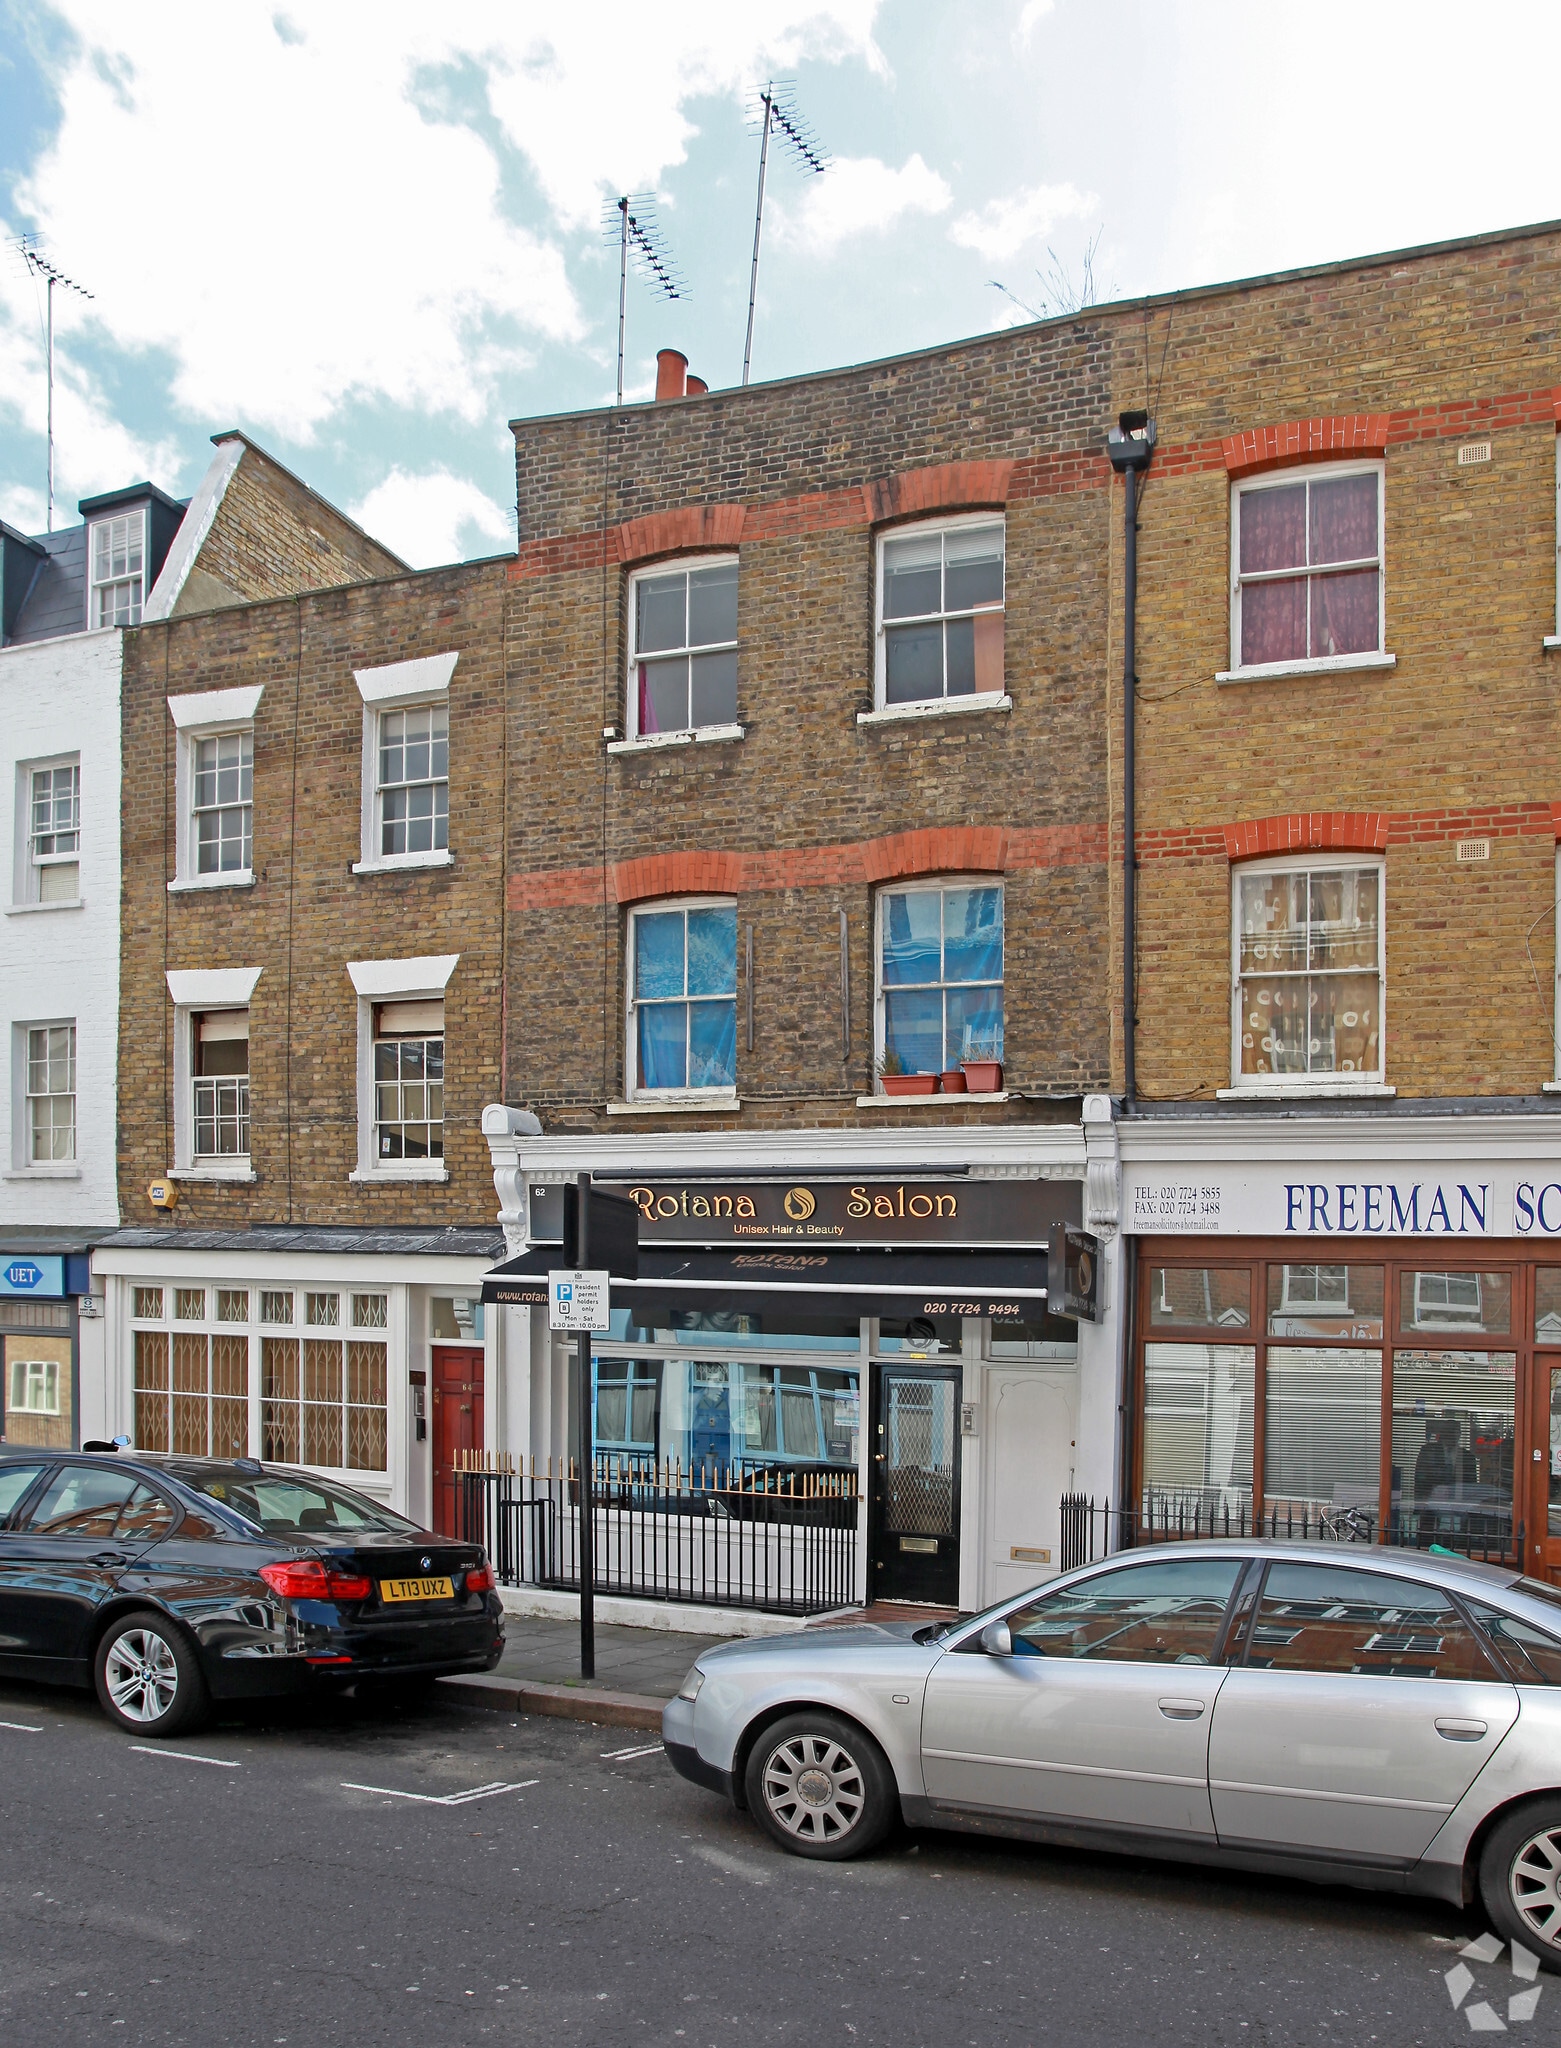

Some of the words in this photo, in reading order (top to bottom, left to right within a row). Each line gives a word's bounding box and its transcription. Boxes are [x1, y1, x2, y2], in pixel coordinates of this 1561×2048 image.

[535, 1188, 546, 1197] 62
[1134, 1186, 1158, 1199] TEL.:
[1160, 1187, 1177, 1199] 020
[1179, 1187, 1197, 1199] 7724
[1201, 1187, 1220, 1199] 5855
[629, 1187, 757, 1220] Rotana
[847, 1185, 957, 1218] Salon
[1134, 1201, 1157, 1214] FAX:
[1159, 1202, 1175, 1214] 020
[1178, 1202, 1196, 1214] 7724
[1200, 1202, 1220, 1214] 3488
[1283, 1184, 1489, 1232] FREEMAN
[733, 1224, 769, 1234] Unisex
[771, 1224, 794, 1234] Hair
[796, 1225, 804, 1234] &
[807, 1224, 844, 1236] Beauty
[730, 1253, 829, 1266] ROTANA
[774, 1263, 806, 1271] Salon
[10, 1268, 36, 1282] UET
[560, 1285, 571, 1299] P
[923, 1303, 947, 1315] 020
[950, 1303, 981, 1315] 7724
[988, 1304, 1020, 1315] 9494
[390, 1582, 420, 1598] LT13
[421, 1580, 446, 1595] UXZ
